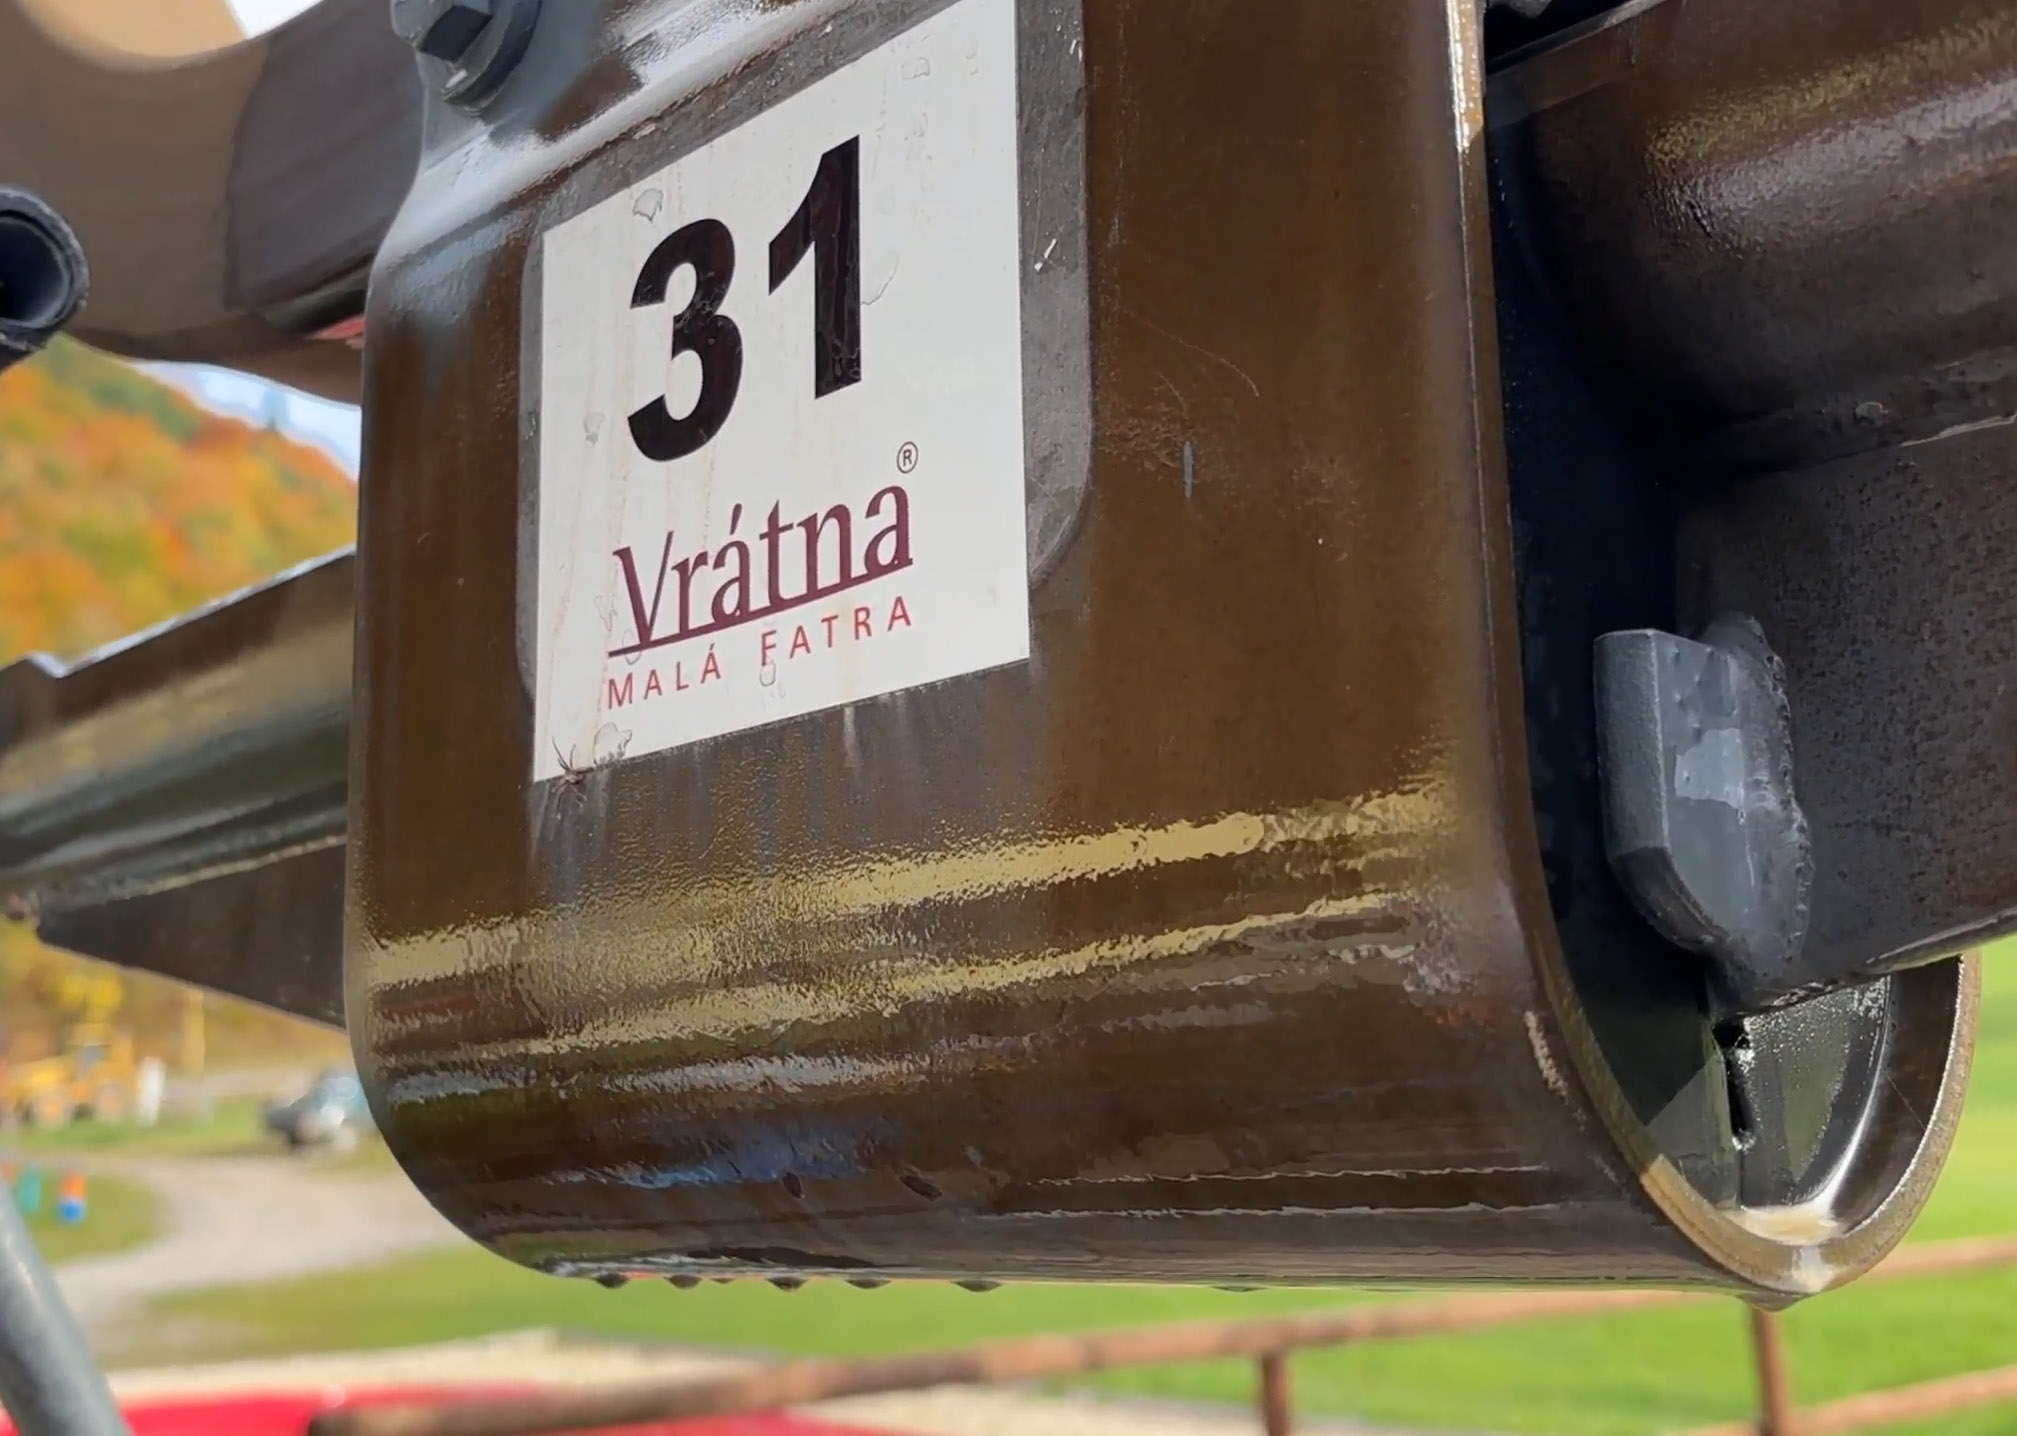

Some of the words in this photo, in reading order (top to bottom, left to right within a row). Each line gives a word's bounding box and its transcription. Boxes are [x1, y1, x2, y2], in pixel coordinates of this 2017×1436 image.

[627, 135, 862, 462] 31
[609, 644, 721, 709] MALÁ
[761, 596, 912, 666] FATRA
[610, 486, 914, 653] Vrátna
